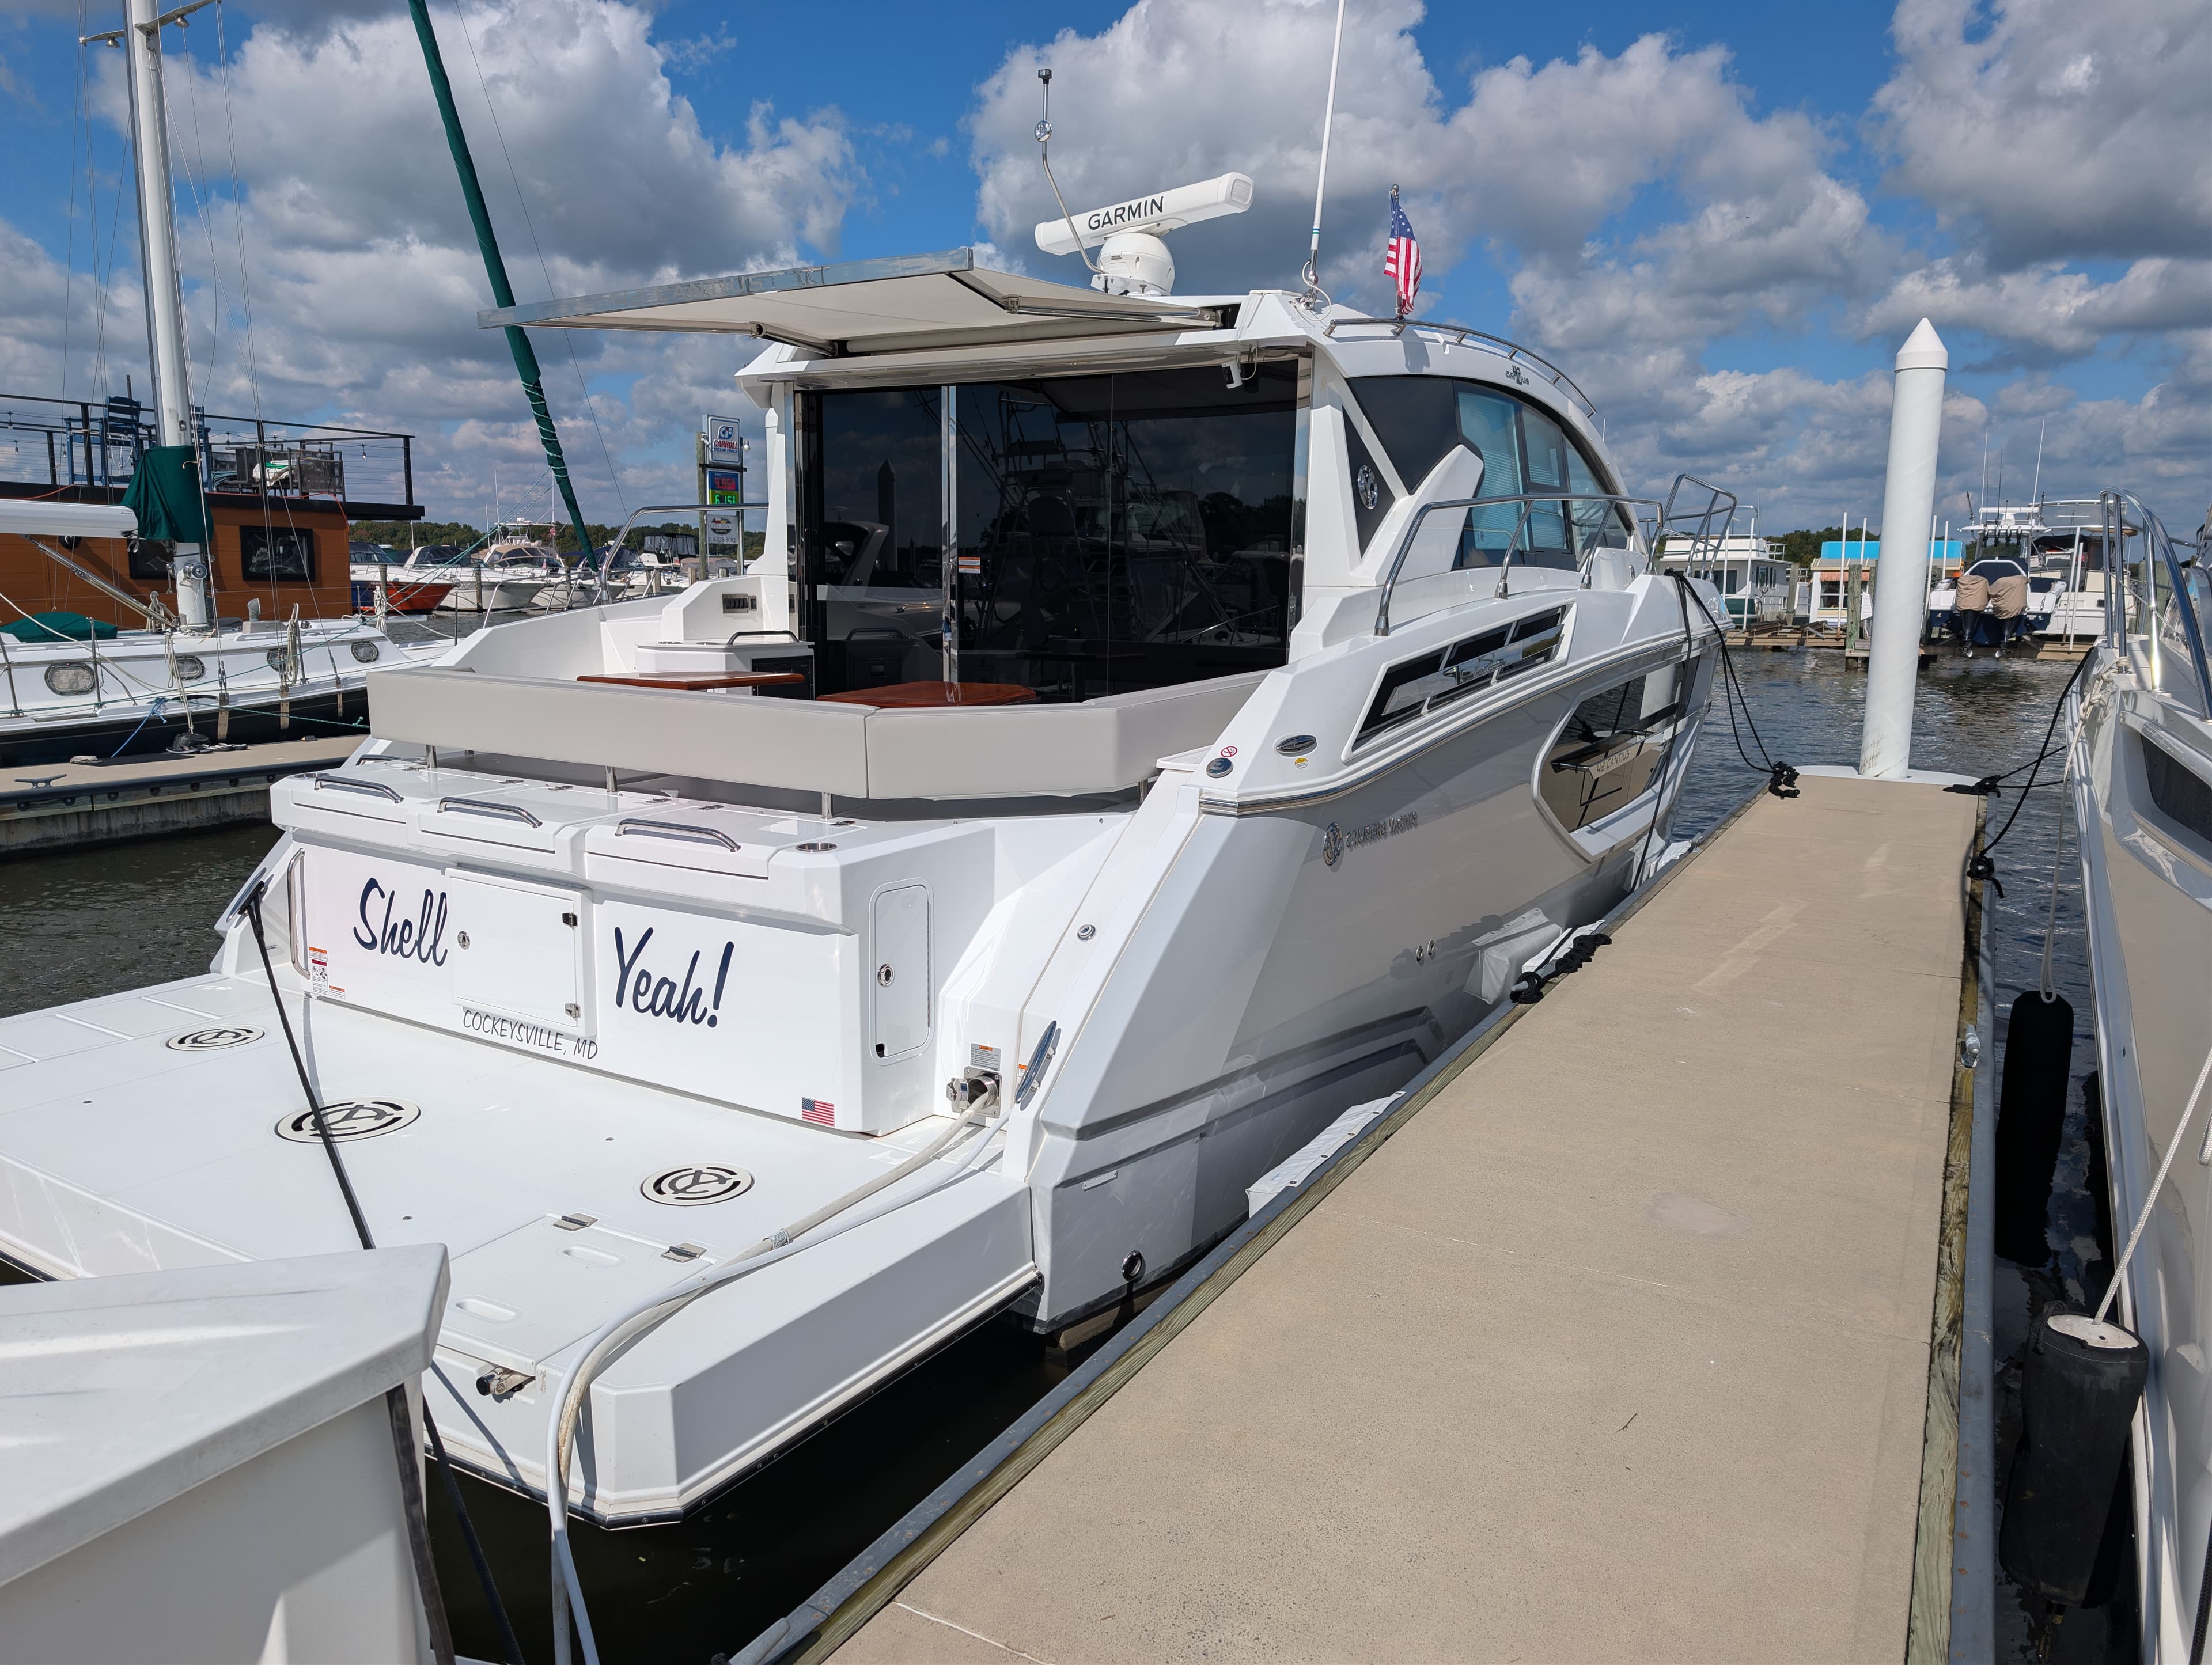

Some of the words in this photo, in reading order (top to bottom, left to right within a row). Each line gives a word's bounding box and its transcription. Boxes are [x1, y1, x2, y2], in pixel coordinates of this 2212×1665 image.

[1088, 196, 1164, 230] GARMIN
[714, 440, 738, 449] CARROLL
[1596, 764, 1605, 773] 42
[1607, 749, 1630, 768] CANTIUS
[353, 877, 448, 967] Shell
[614, 927, 734, 1029] Yeah!
[463, 1009, 567, 1056] COCKEYSVILLE,
[574, 1037, 599, 1060] MD
